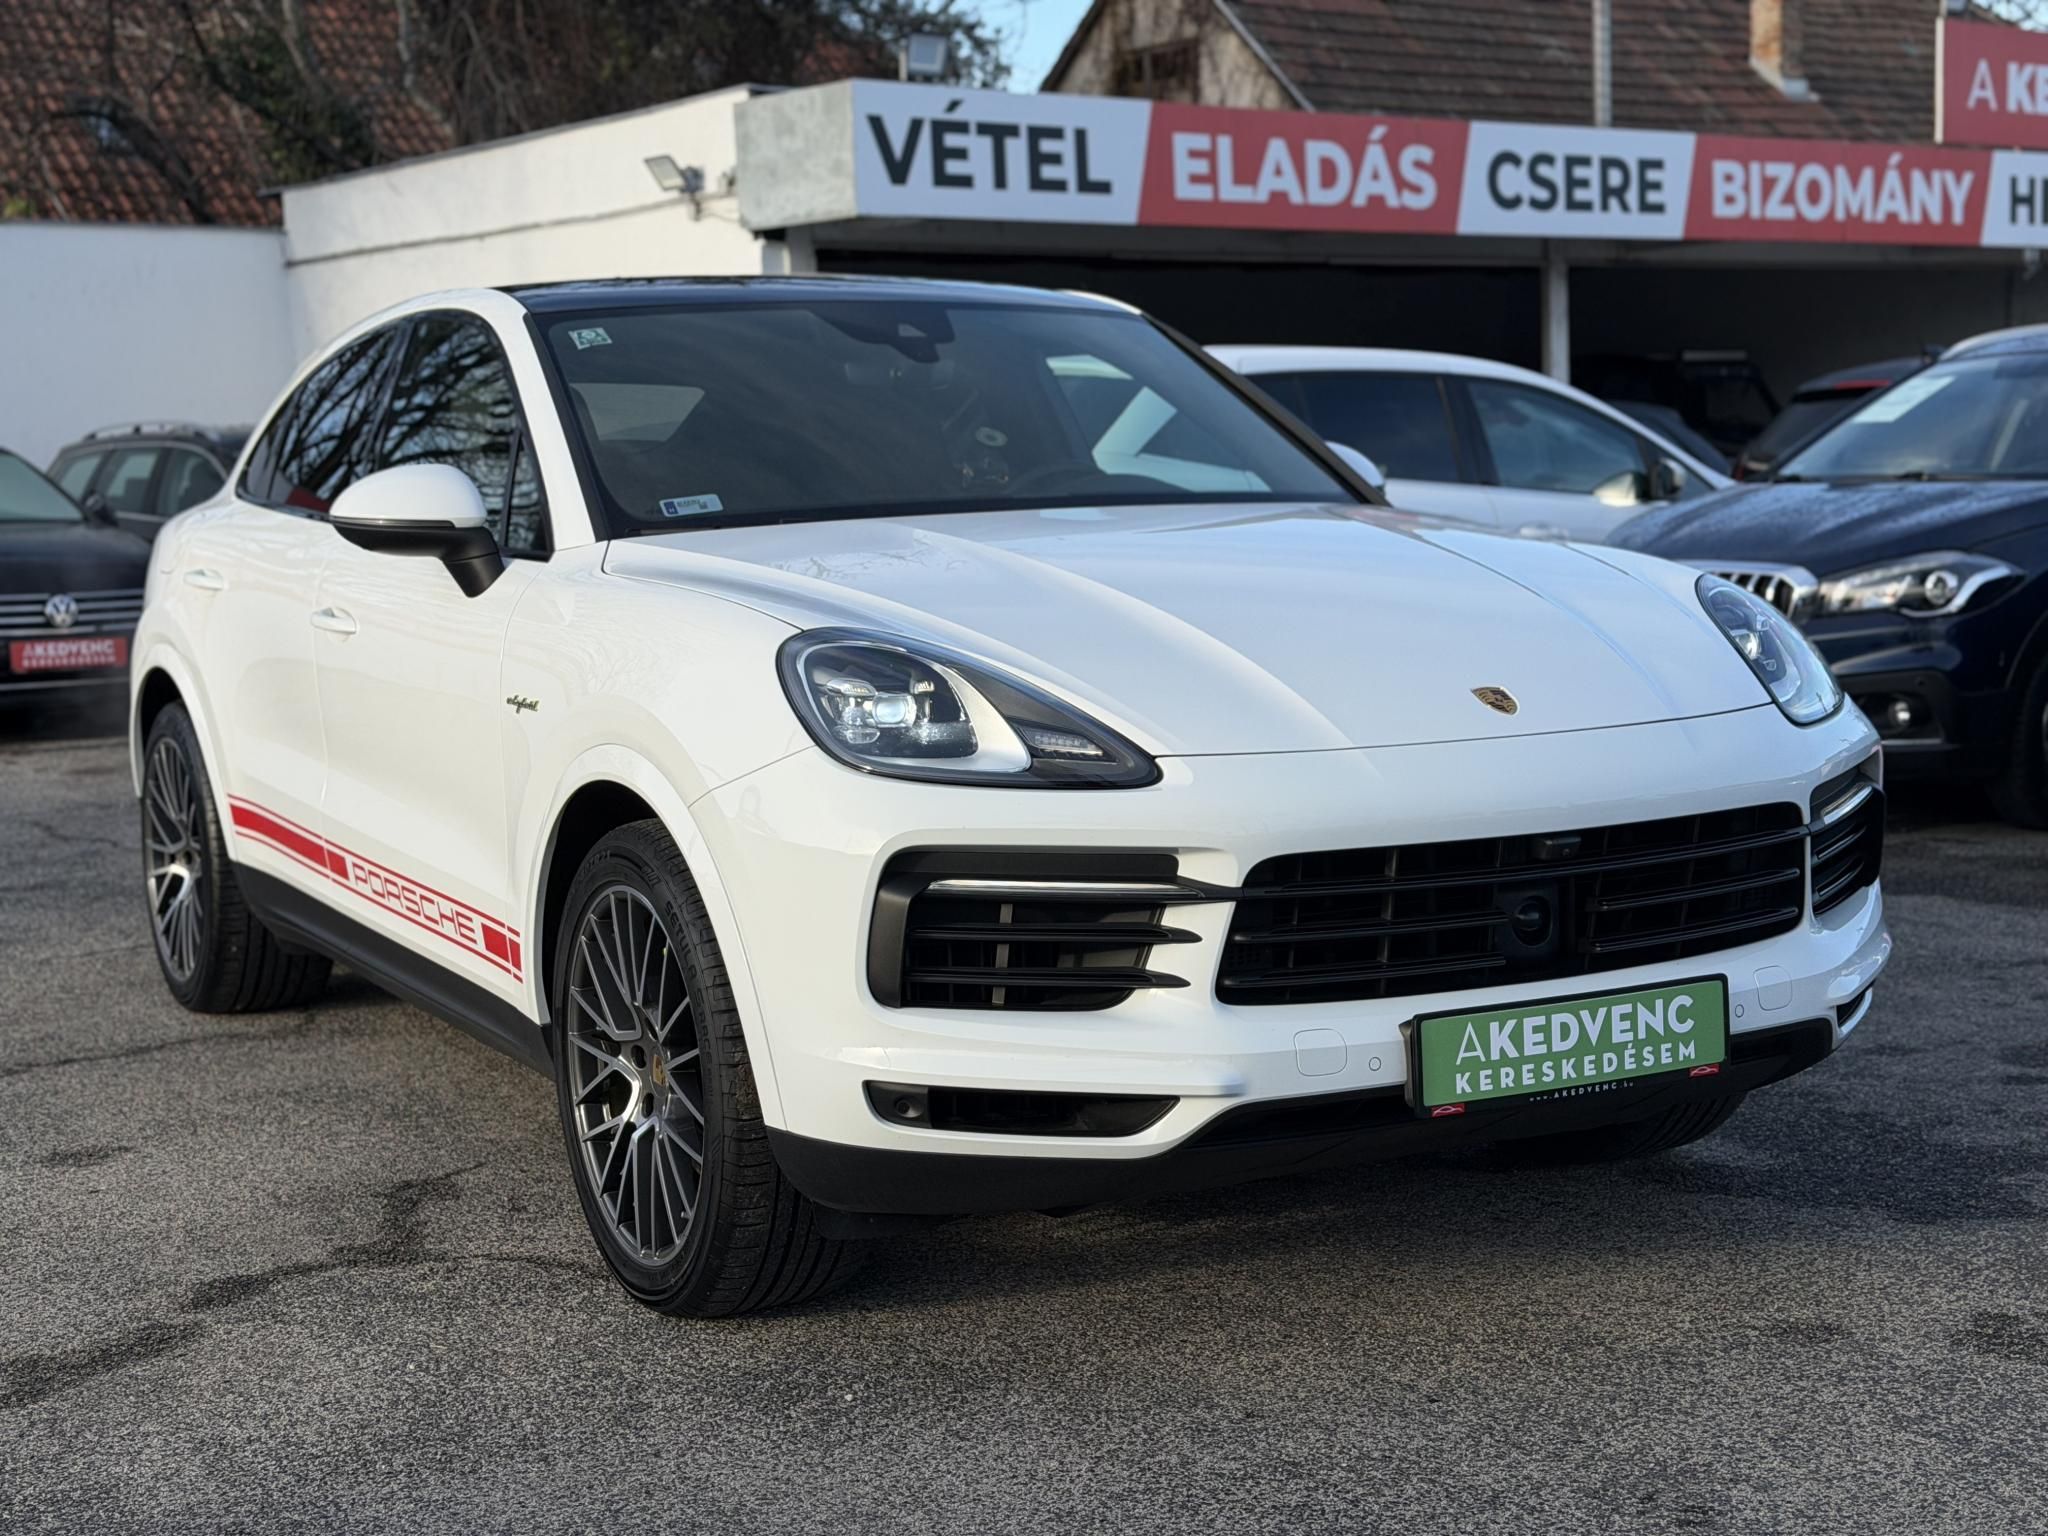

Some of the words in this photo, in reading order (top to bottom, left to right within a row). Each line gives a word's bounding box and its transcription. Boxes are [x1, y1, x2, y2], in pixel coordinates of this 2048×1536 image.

[1967, 58, 1998, 112] A
[866, 100, 1112, 195] VÉTEL
[1172, 126, 1438, 210] ELADÁS
[1487, 150, 1666, 215] CSERE
[1711, 153, 1974, 225] BIZOMÁNY
[351, 861, 478, 945] PORSCHE
[1455, 1039, 1696, 1095] KERESKEDÉSEM
